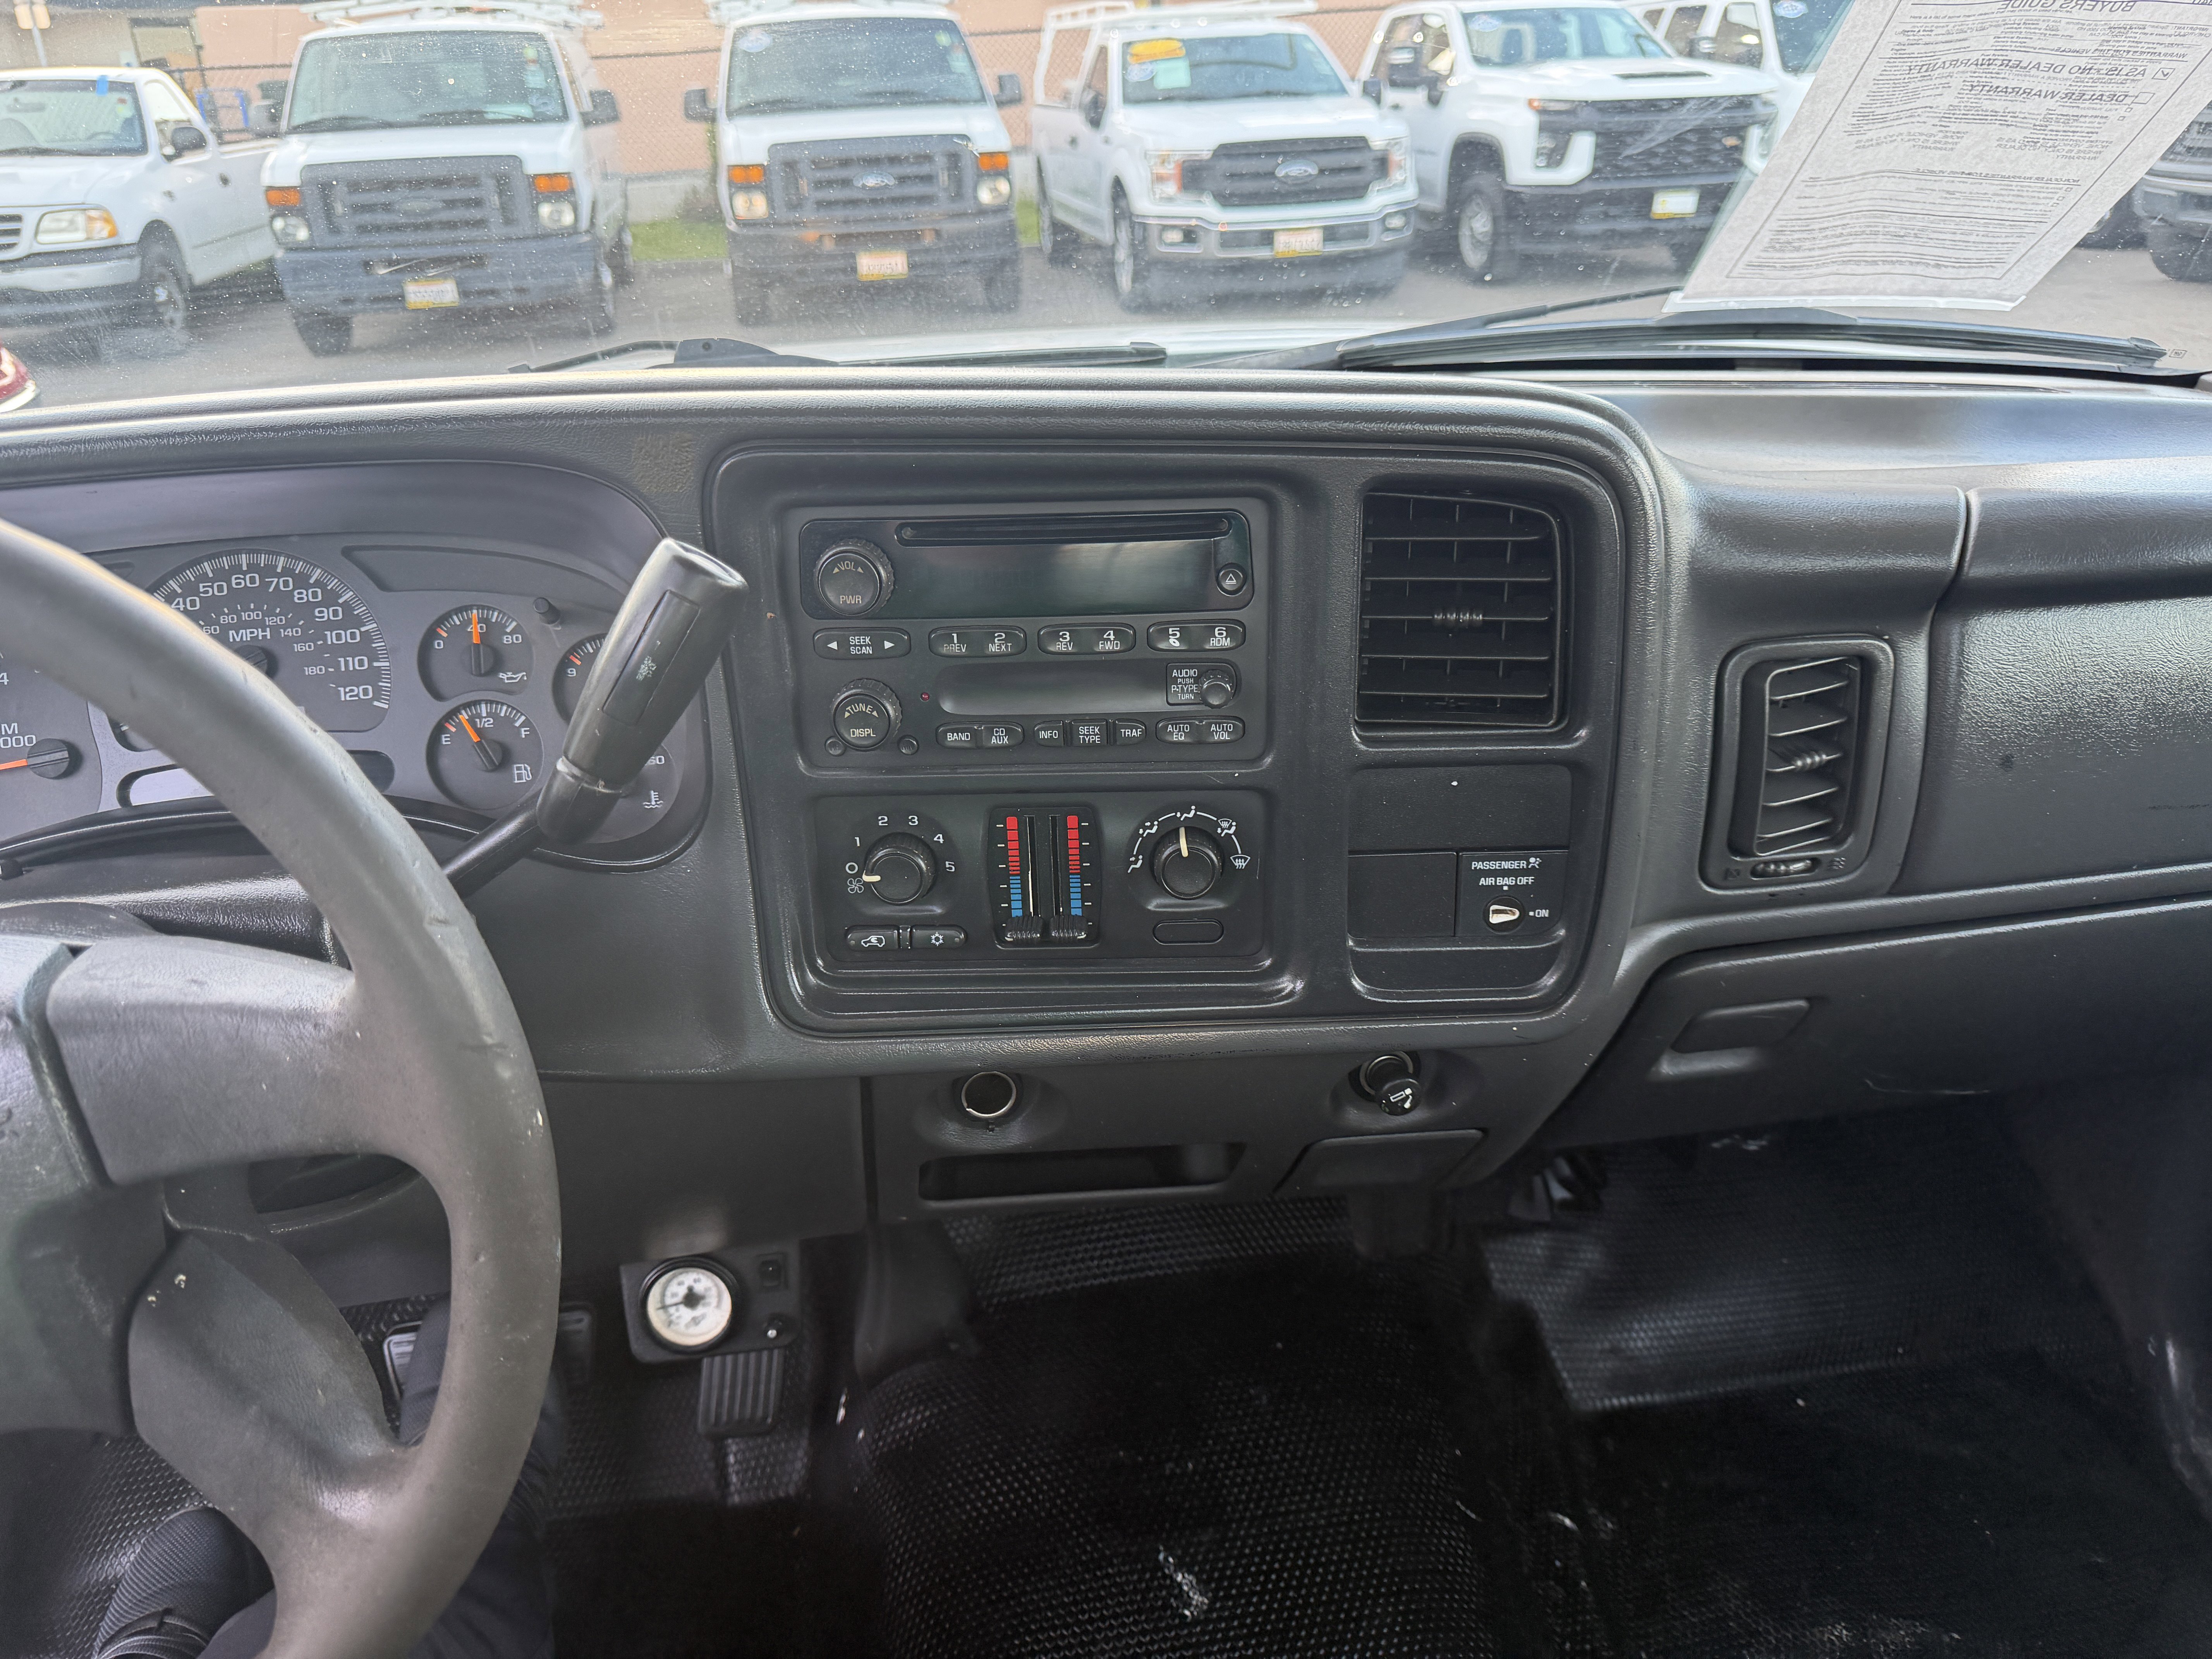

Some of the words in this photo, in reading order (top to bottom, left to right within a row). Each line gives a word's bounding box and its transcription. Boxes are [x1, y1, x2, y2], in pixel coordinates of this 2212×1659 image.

[837, 561, 855, 571] VOL
[231, 574, 259, 588] 60
[265, 577, 293, 592] 70
[199, 582, 227, 597] 50
[294, 588, 322, 603] 80
[840, 595, 862, 604] PWR
[171, 596, 200, 611] 40
[241, 611, 262, 620] 100
[314, 606, 343, 621] 90
[220, 615, 237, 624] 80
[264, 616, 285, 625] 120
[203, 625, 220, 635] 60
[229, 627, 270, 642] MPH
[280, 628, 301, 637] 140
[1168, 628, 1180, 638] 5
[1215, 627, 1226, 637] 6
[324, 629, 360, 644] 100
[503, 634, 522, 644] 80
[952, 633, 957, 644] 1
[994, 632, 1005, 643] 2
[1059, 631, 1070, 642] 3
[1103, 630, 1115, 641] 4
[434, 640, 444, 649] 0
[849, 636, 871, 645] SEEK
[1210, 637, 1230, 646] RDM
[293, 642, 314, 652] 160
[850, 646, 872, 654] SCAN
[944, 644, 967, 652] PREV
[989, 643, 1012, 652] NEXT
[1056, 642, 1073, 651] REV
[1099, 641, 1120, 650] FWD
[338, 656, 368, 671] 110
[304, 666, 325, 675] 180
[567, 668, 576, 677] 9
[1172, 669, 1197, 677] AUDIO
[337, 685, 373, 701] 120
[846, 703, 872, 714] TUNE
[475, 718, 494, 728] 1/2
[850, 728, 876, 737] DISPL
[1079, 726, 1100, 734] SEEK
[1167, 724, 1190, 732] AUTO
[521, 728, 530, 738] F
[947, 733, 970, 741] BAND
[1039, 730, 1058, 738] INFO
[1120, 729, 1142, 737] TRAF
[1173, 732, 1185, 740] EQ
[1213, 731, 1230, 740] VOL
[442, 734, 451, 745] E
[991, 735, 1008, 744] AUX
[1079, 735, 1101, 744] TYPE
[878, 816, 888, 826] 2
[908, 816, 918, 825] 3
[855, 837, 860, 847] 1
[933, 834, 944, 843] 4
[945, 861, 955, 872] 5
[1472, 860, 1527, 870] PASSENGER
[1479, 877, 1495, 886] AIR
[1496, 877, 1516, 885] BAG
[1517, 876, 1535, 885] OFF
[1535, 909, 1549, 917] ON
